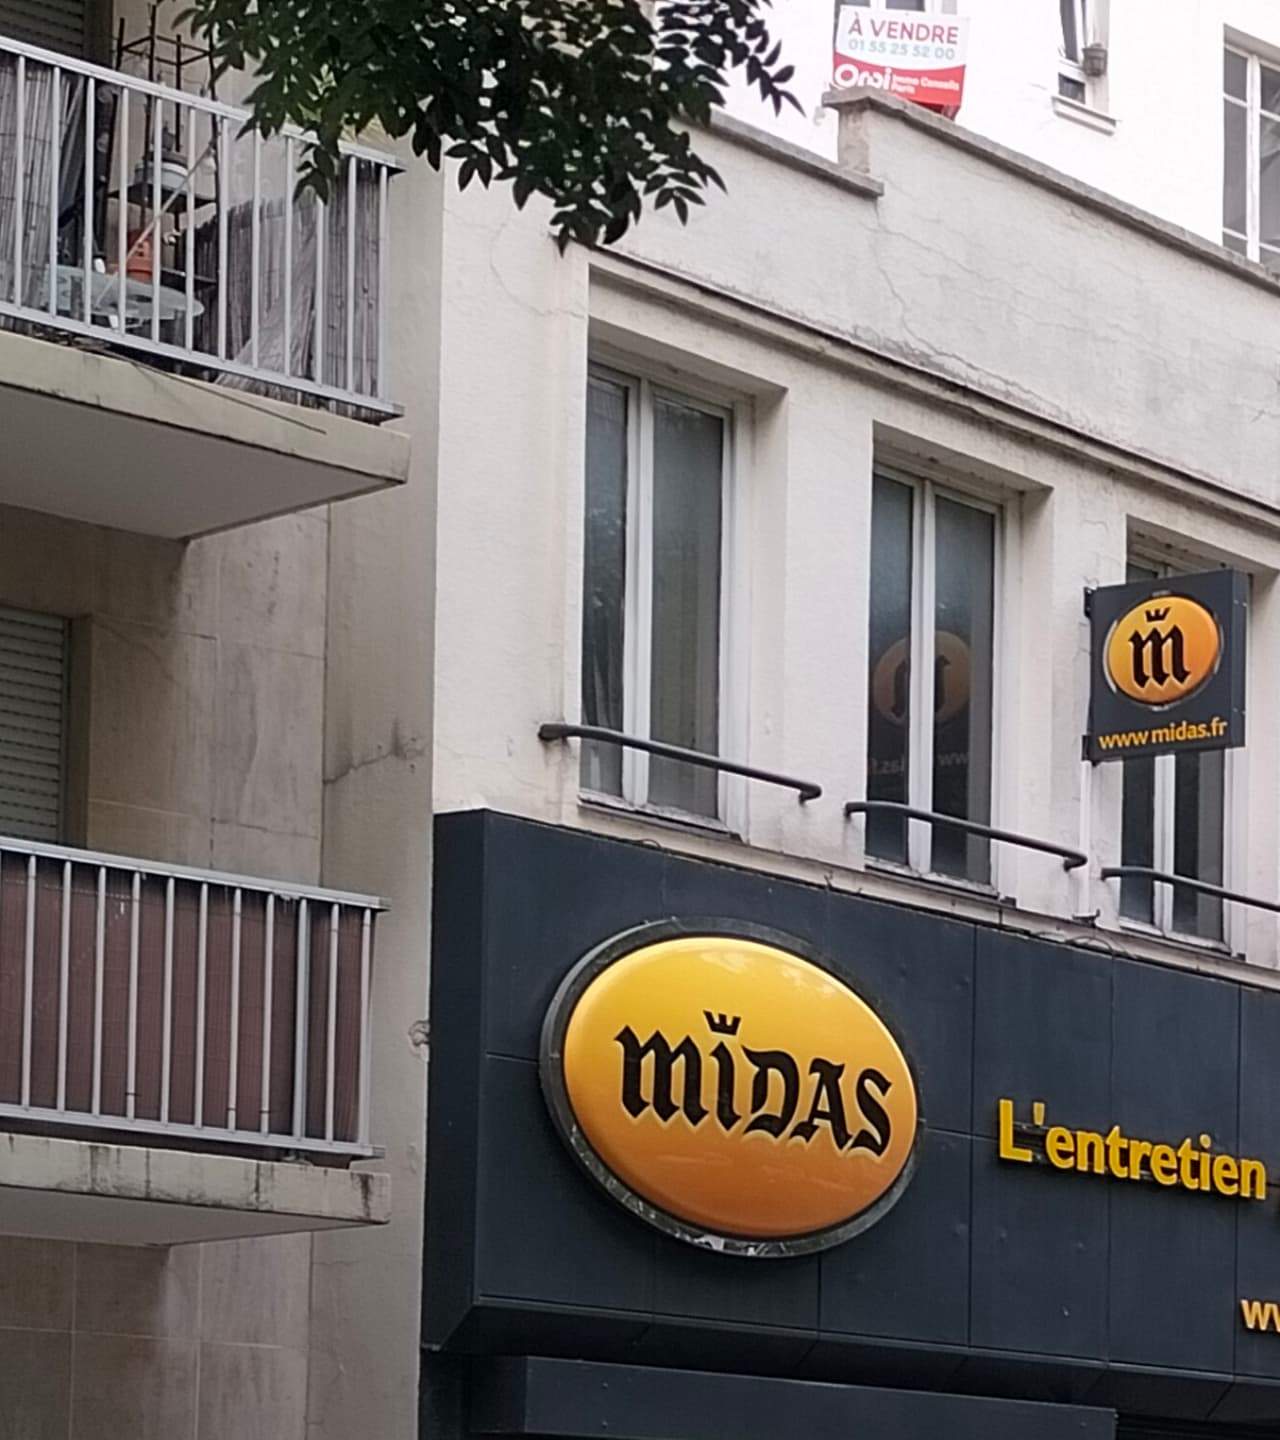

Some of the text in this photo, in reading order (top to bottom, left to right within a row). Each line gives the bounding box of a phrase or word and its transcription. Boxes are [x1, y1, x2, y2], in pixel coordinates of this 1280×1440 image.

[848, 11, 959, 45] À VENDRE
[1099, 716, 1228, 749] wwwmidas.fr
[999, 1099, 1266, 1200] L'entretien
